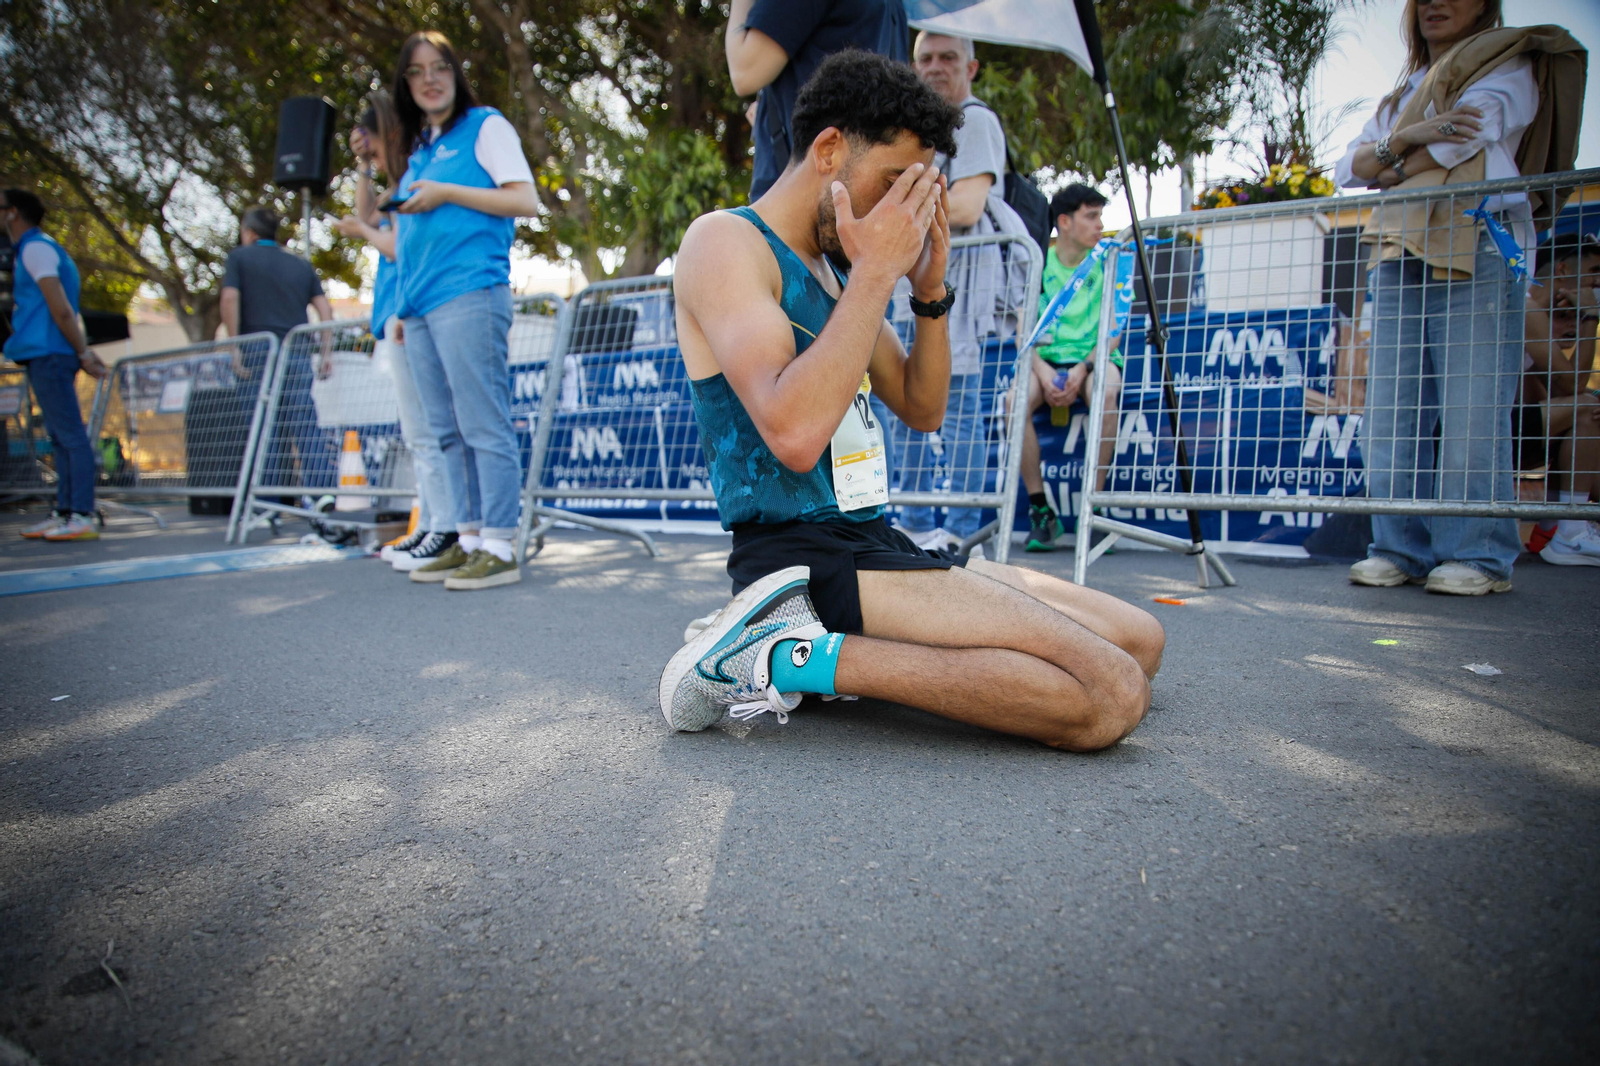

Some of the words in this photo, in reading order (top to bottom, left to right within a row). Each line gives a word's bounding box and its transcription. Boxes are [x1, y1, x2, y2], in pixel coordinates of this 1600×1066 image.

[514, 369, 547, 399] M
[1302, 414, 1364, 458] M
[1260, 465, 1335, 486] Medio
